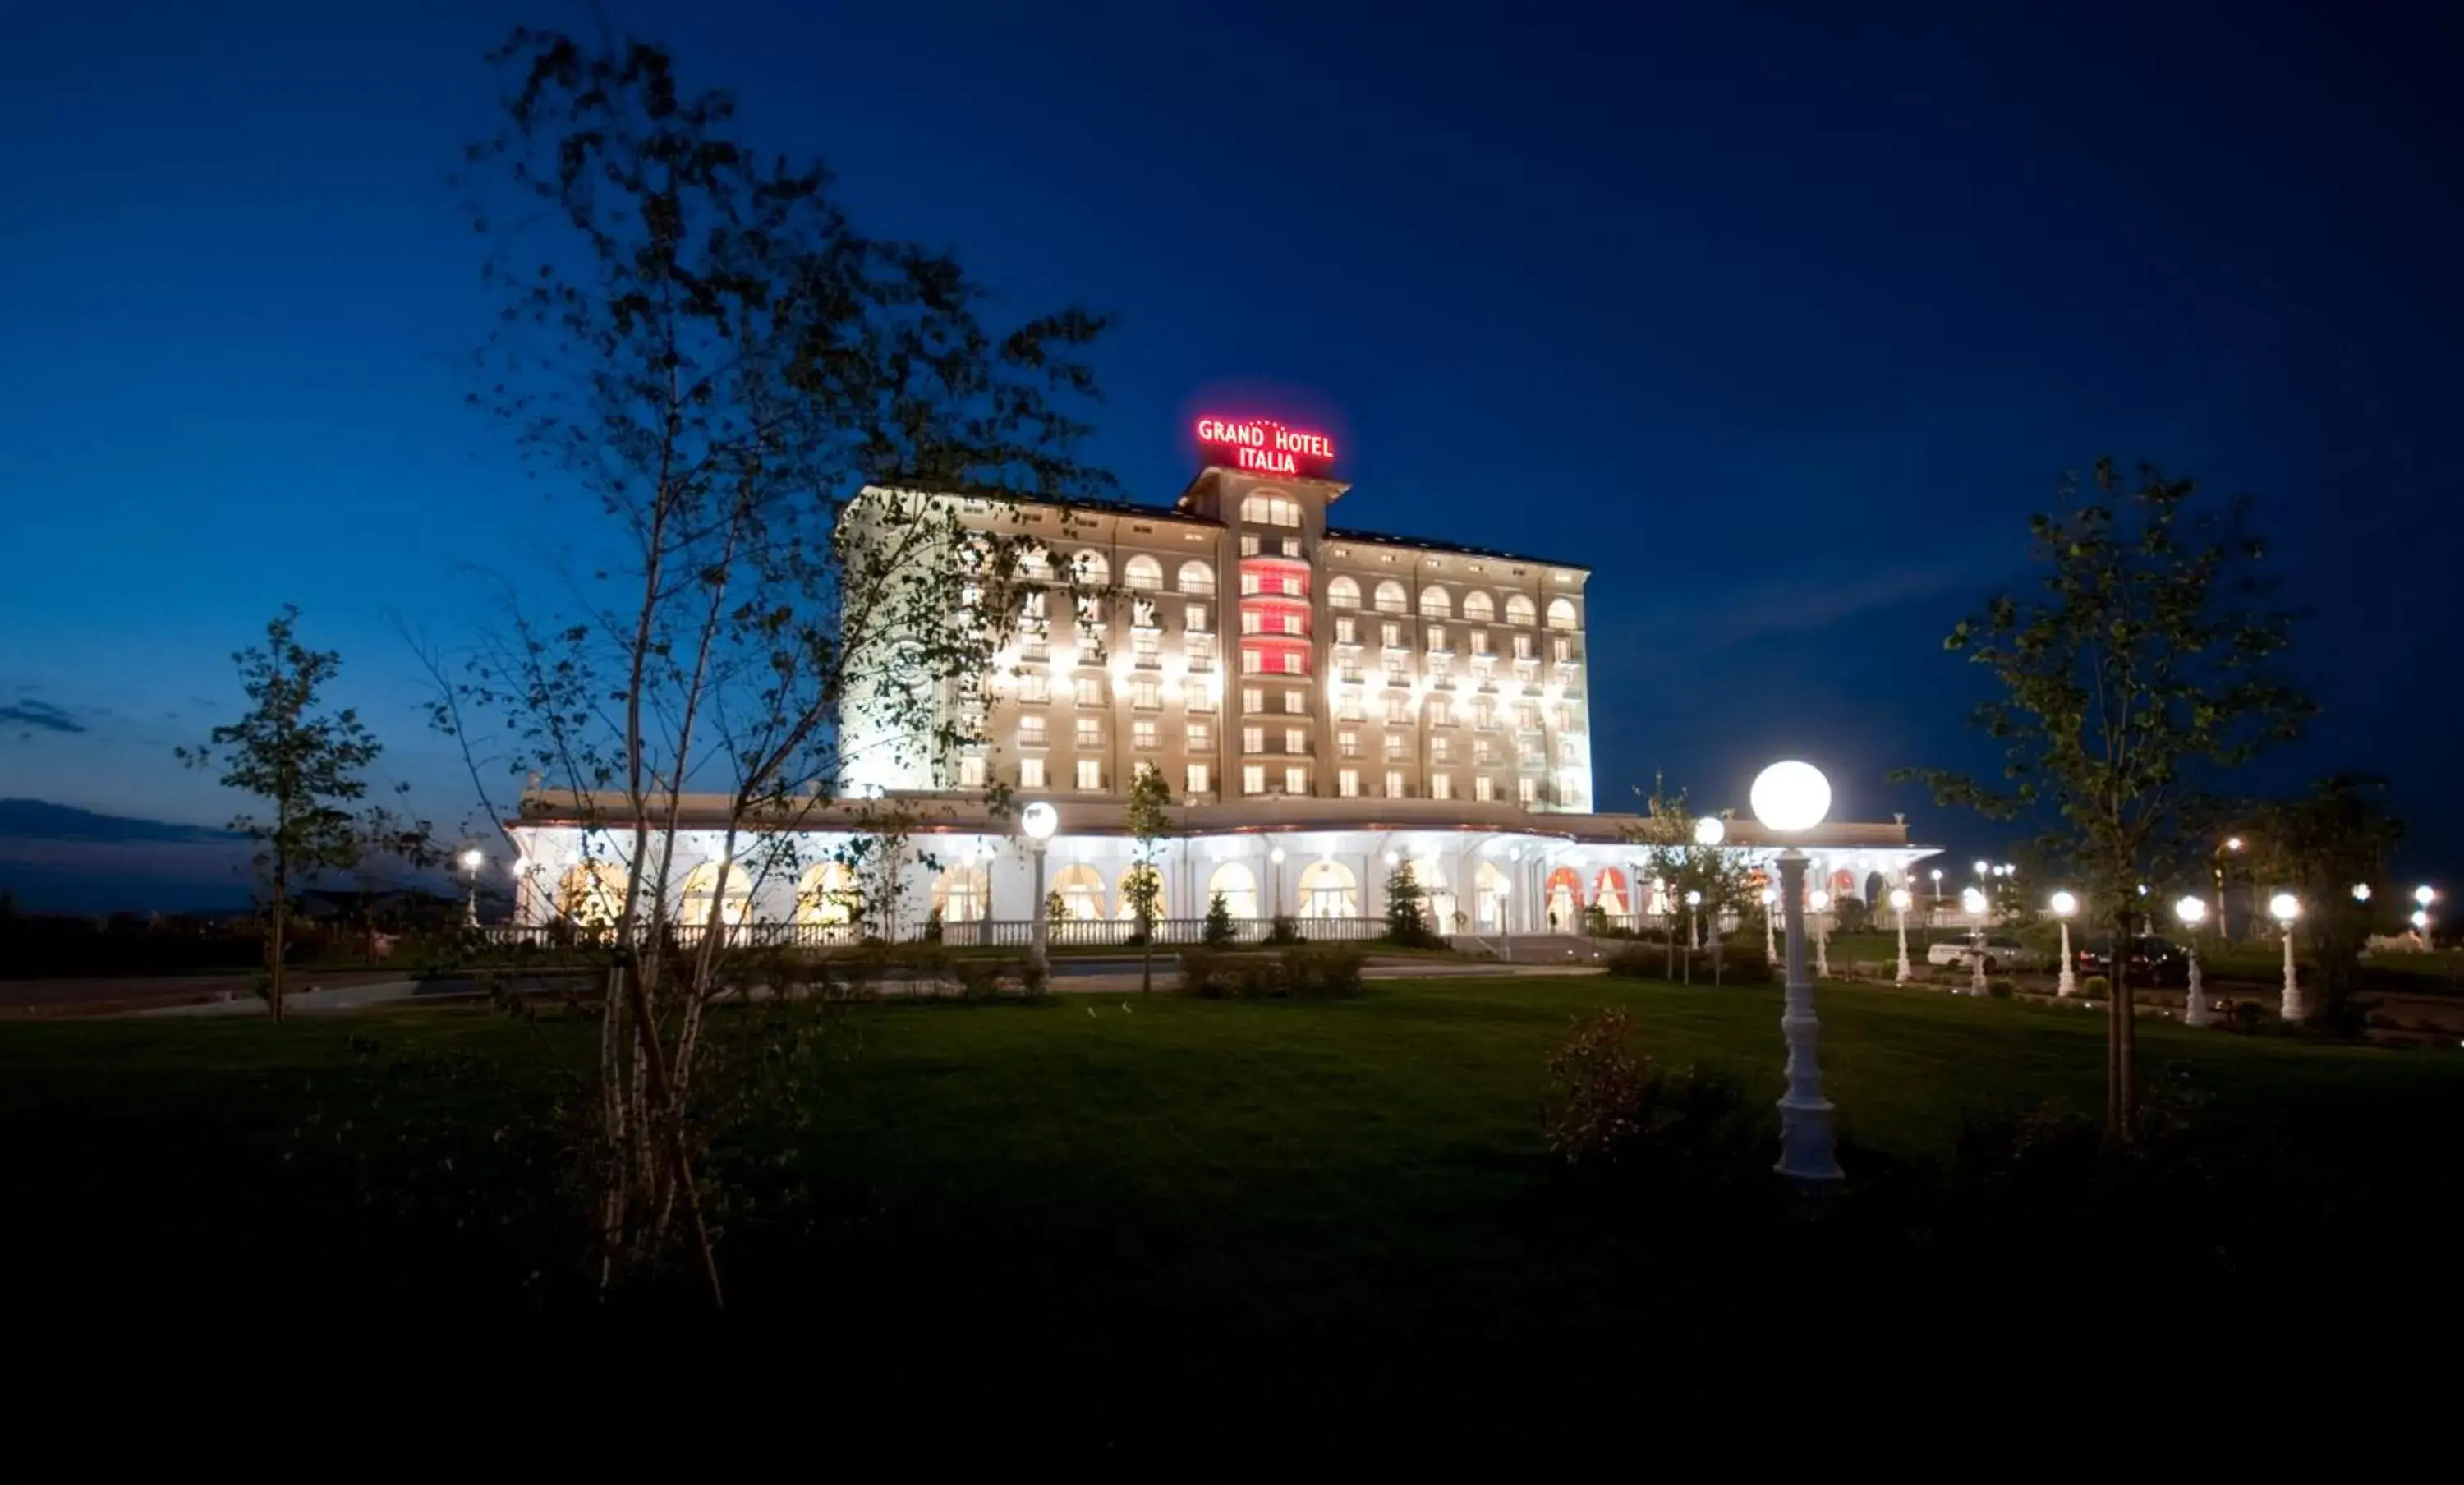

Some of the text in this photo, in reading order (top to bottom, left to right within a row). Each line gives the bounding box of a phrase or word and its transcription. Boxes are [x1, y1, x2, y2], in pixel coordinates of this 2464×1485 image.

[1198, 420, 1334, 457] GRAND HOTEL
[1240, 448, 1295, 474] ITALIA
